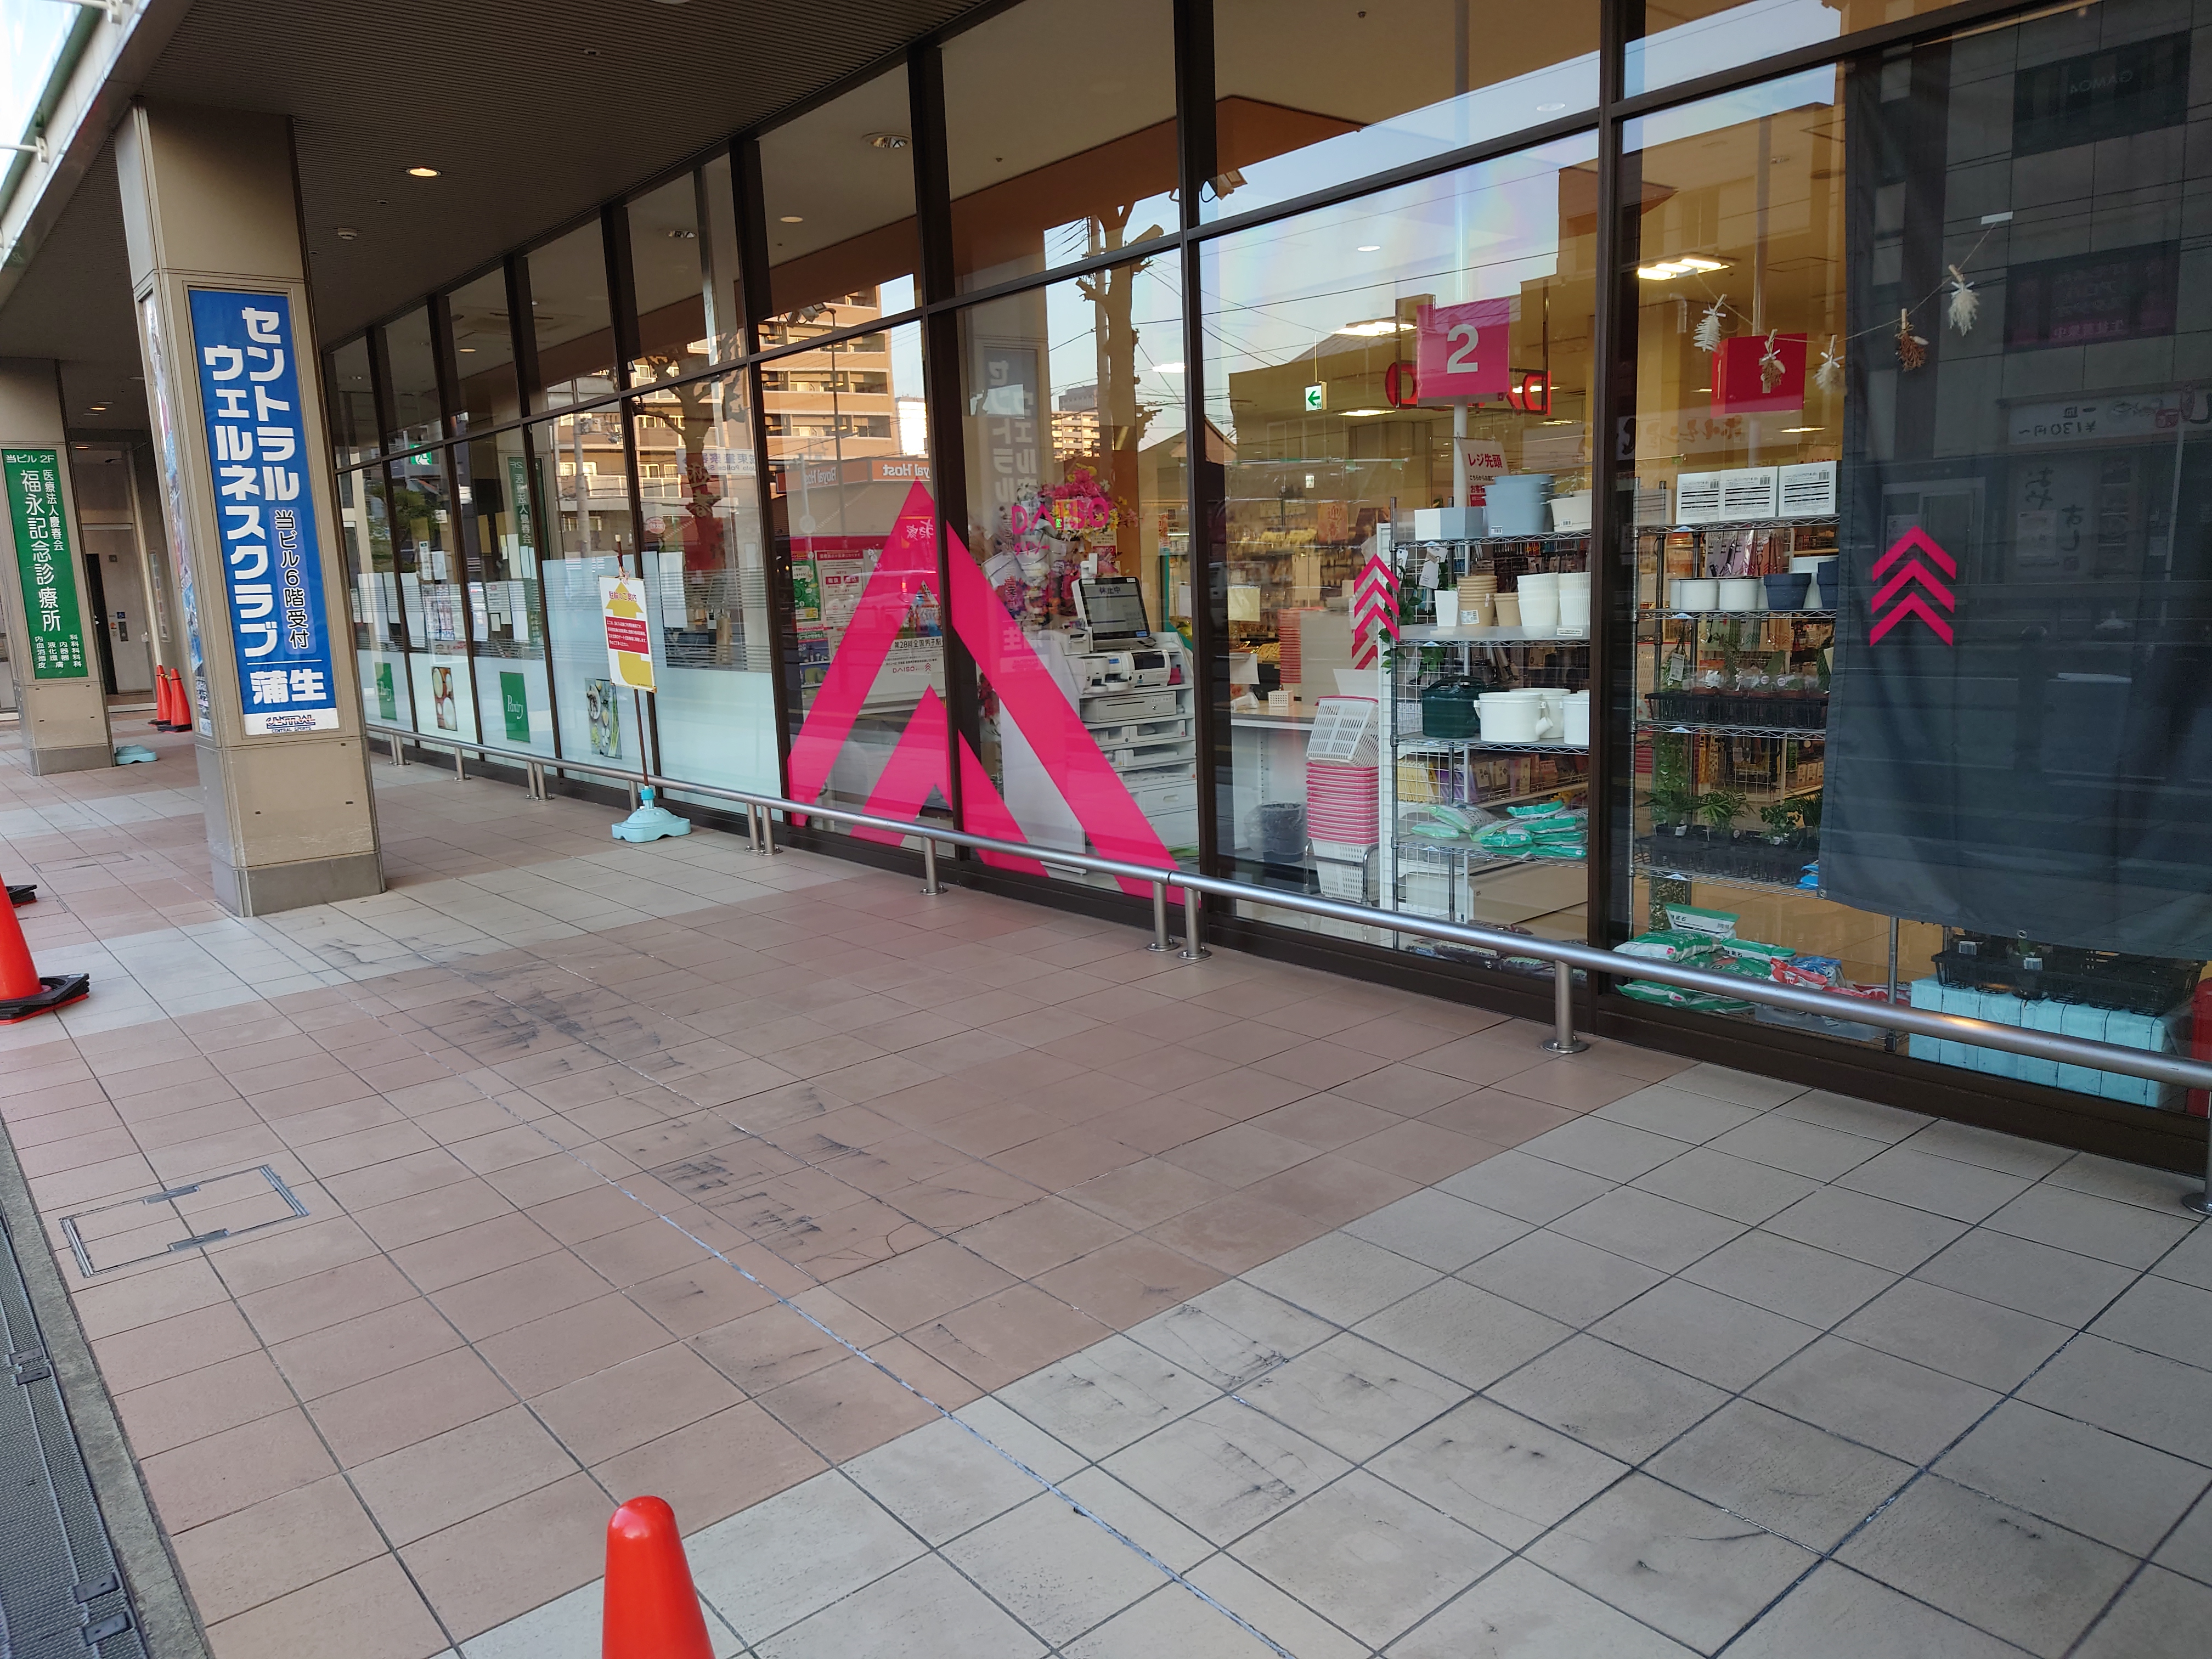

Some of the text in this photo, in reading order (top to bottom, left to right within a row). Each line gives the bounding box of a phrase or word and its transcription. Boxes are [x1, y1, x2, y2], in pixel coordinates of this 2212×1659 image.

[1447, 324, 1479, 374] 2
[241, 307, 300, 500] セントラル
[6, 454, 55, 464] 当ビル 2F
[1468, 453, 1503, 468] レジ先頭
[43, 469, 64, 551] 医療法人慶春会
[1012, 497, 1109, 534] DAISO
[20, 469, 61, 633] 福永記念診療所
[1014, 540, 1050, 556] ダイソー
[274, 509, 311, 649] 当ビル6階受付
[1099, 586, 1121, 594] 休止中
[894, 638, 943, 649] 第28回全国男子駅
[250, 668, 327, 704] 蒲生
[507, 695, 523, 719] Pantry
